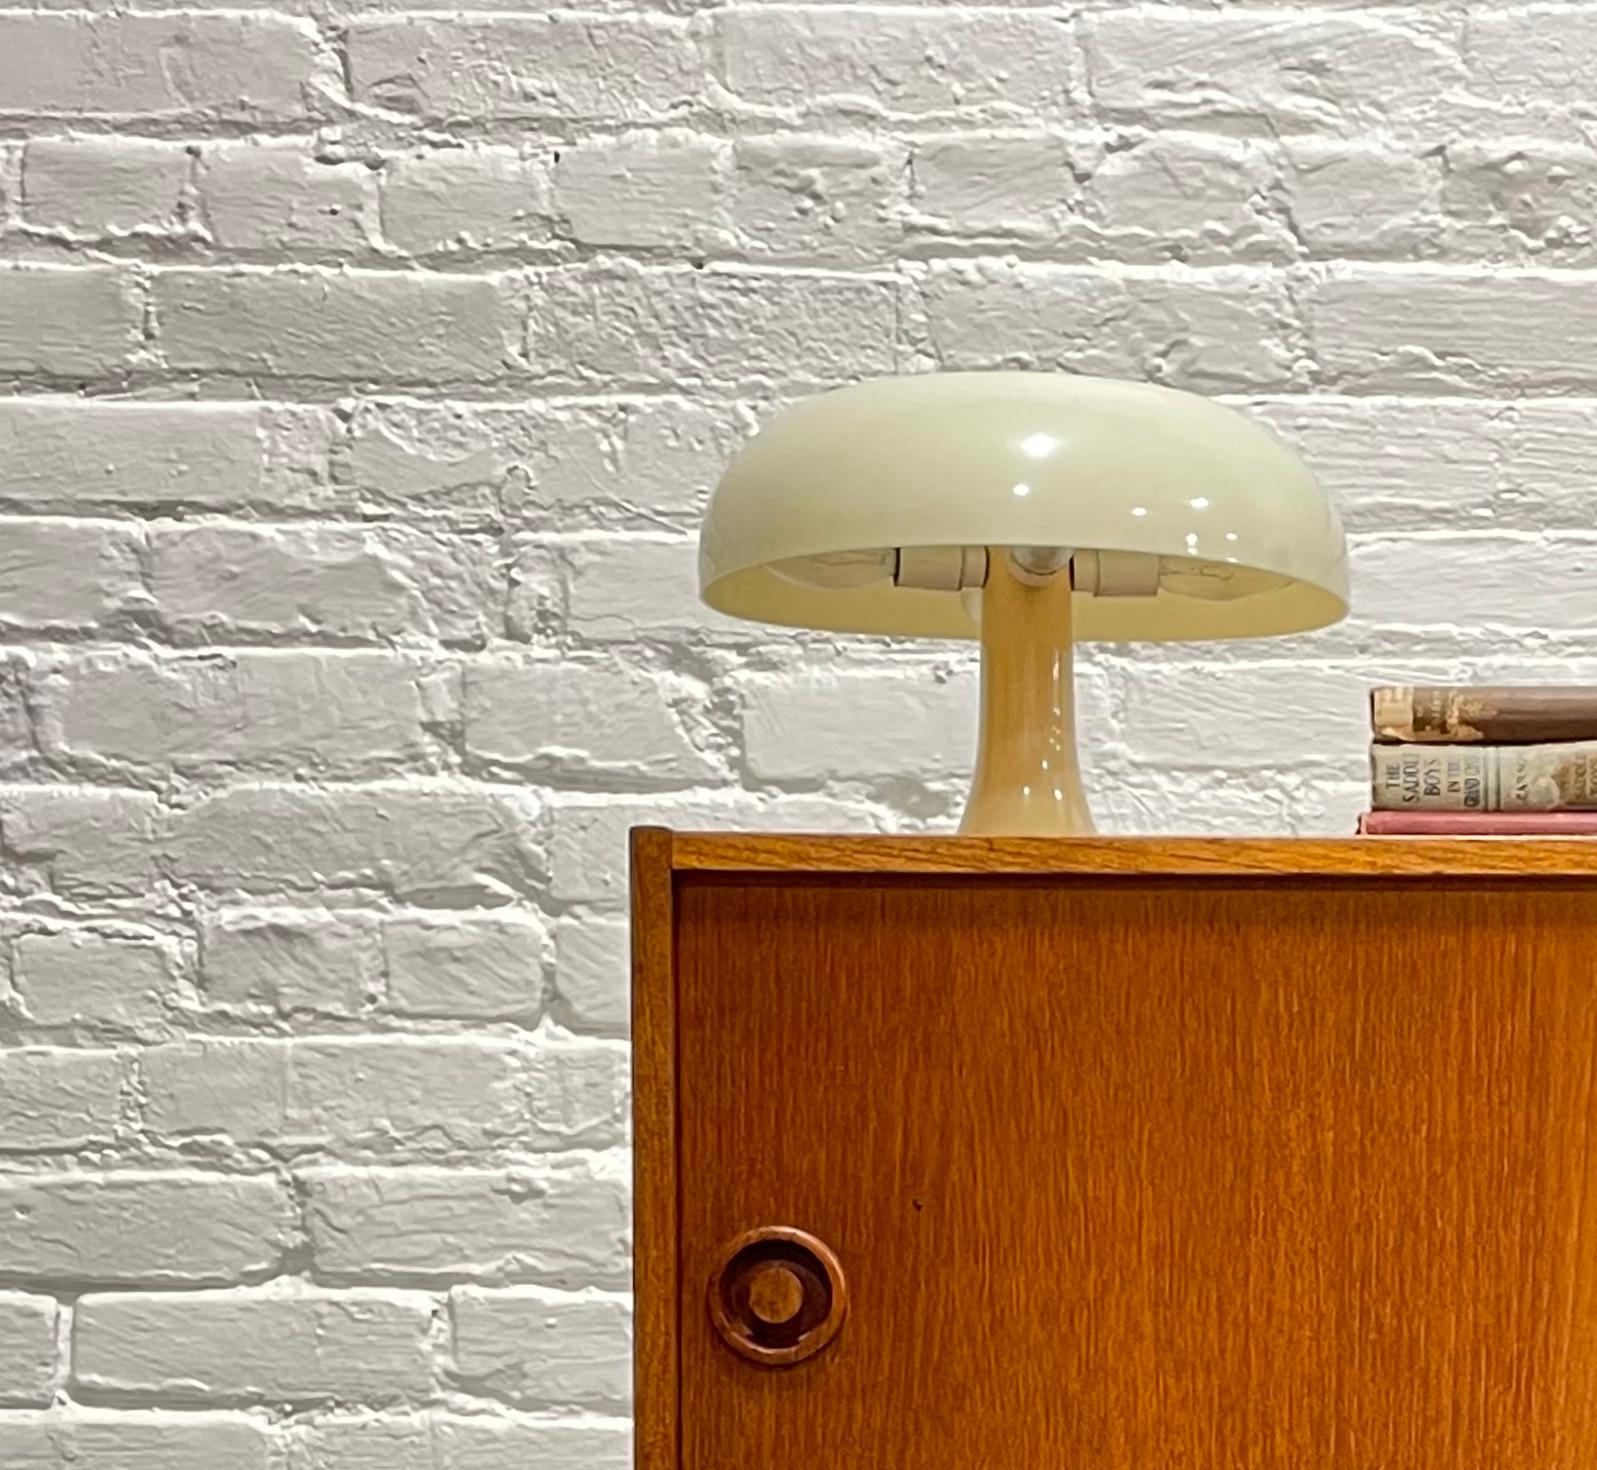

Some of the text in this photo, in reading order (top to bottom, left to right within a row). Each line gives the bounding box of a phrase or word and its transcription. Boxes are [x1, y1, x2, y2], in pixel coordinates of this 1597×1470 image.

[1386, 763, 1400, 790] THE
[1423, 758, 1441, 797] BOYS
[1447, 780, 1460, 793] IN
